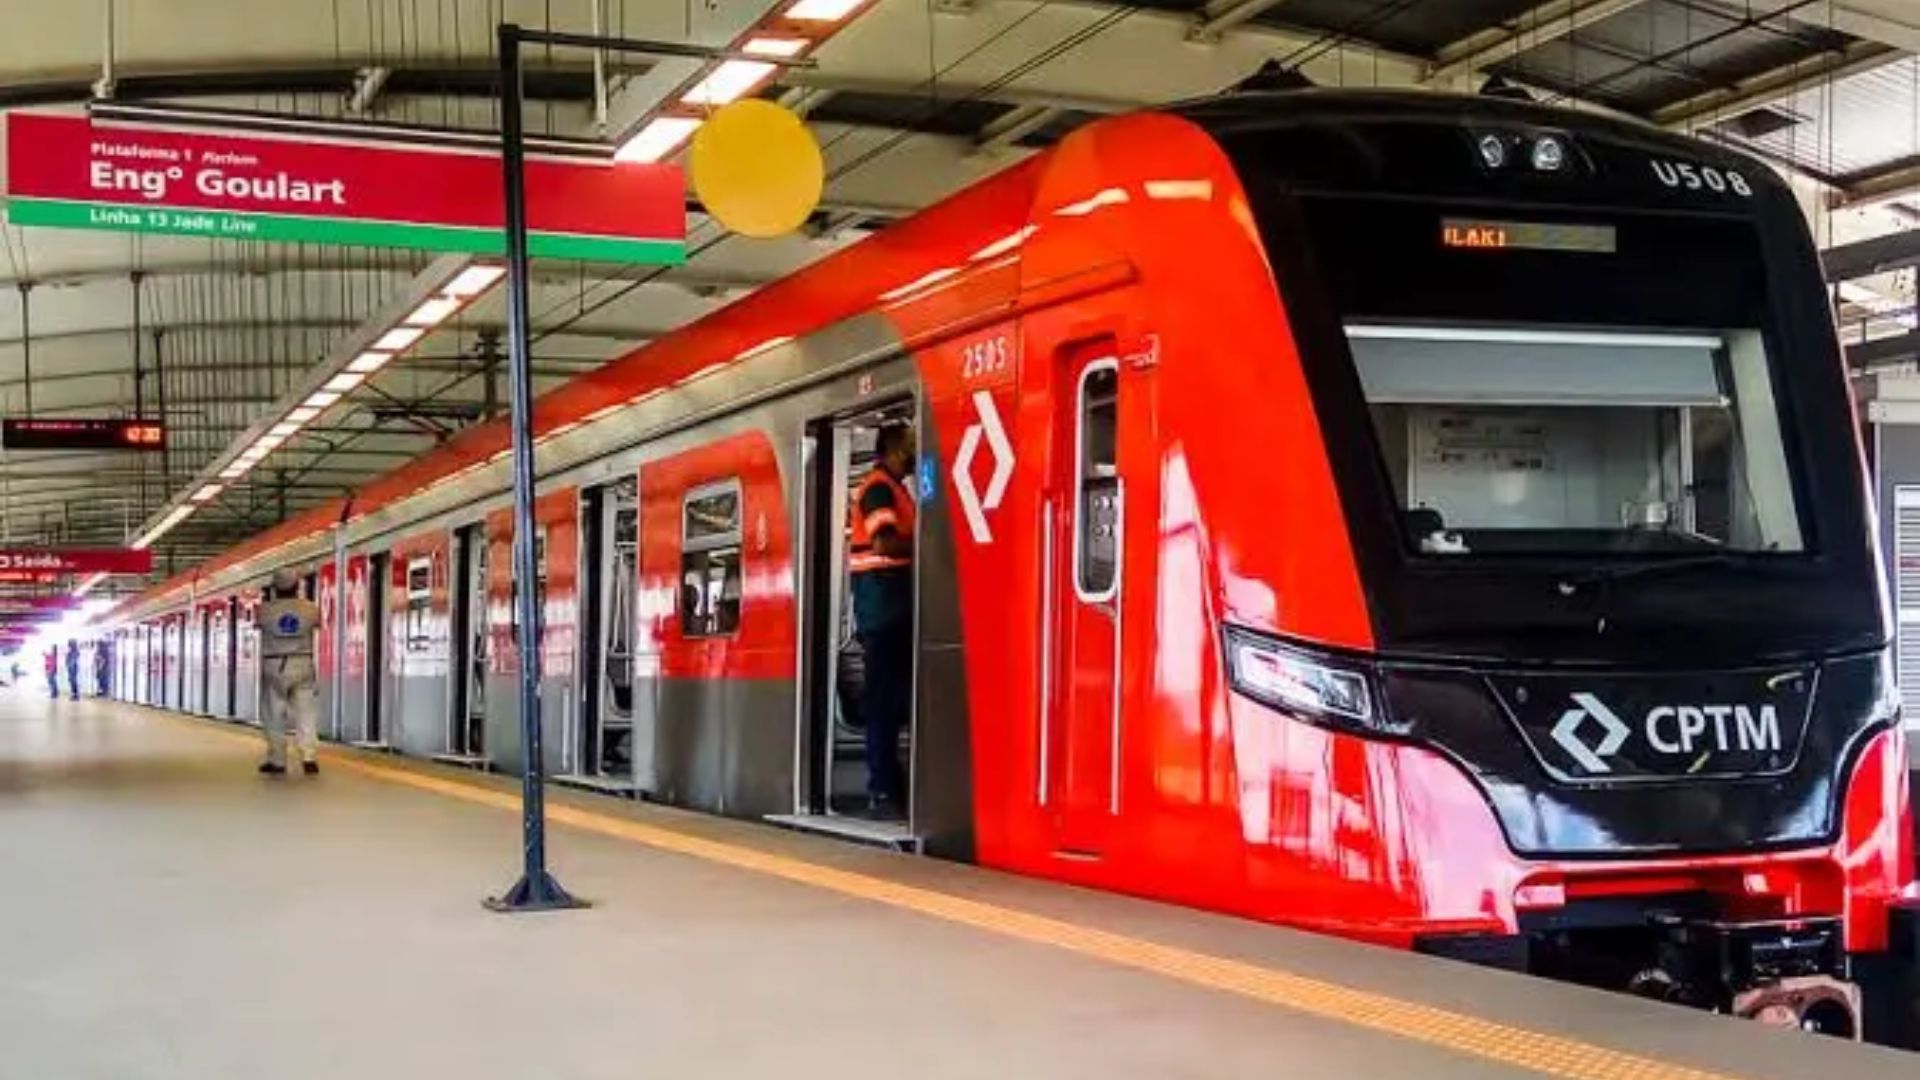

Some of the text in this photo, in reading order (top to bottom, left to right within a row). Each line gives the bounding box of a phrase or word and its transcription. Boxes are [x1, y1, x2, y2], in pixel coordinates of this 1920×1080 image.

[89, 142, 180, 161] Plataforma
[196, 168, 346, 205] Goulart
[1650, 160, 1753, 196] U508
[90, 208, 258, 233] Linha 13 Jade Line
[1646, 705, 1782, 753] CPTM
